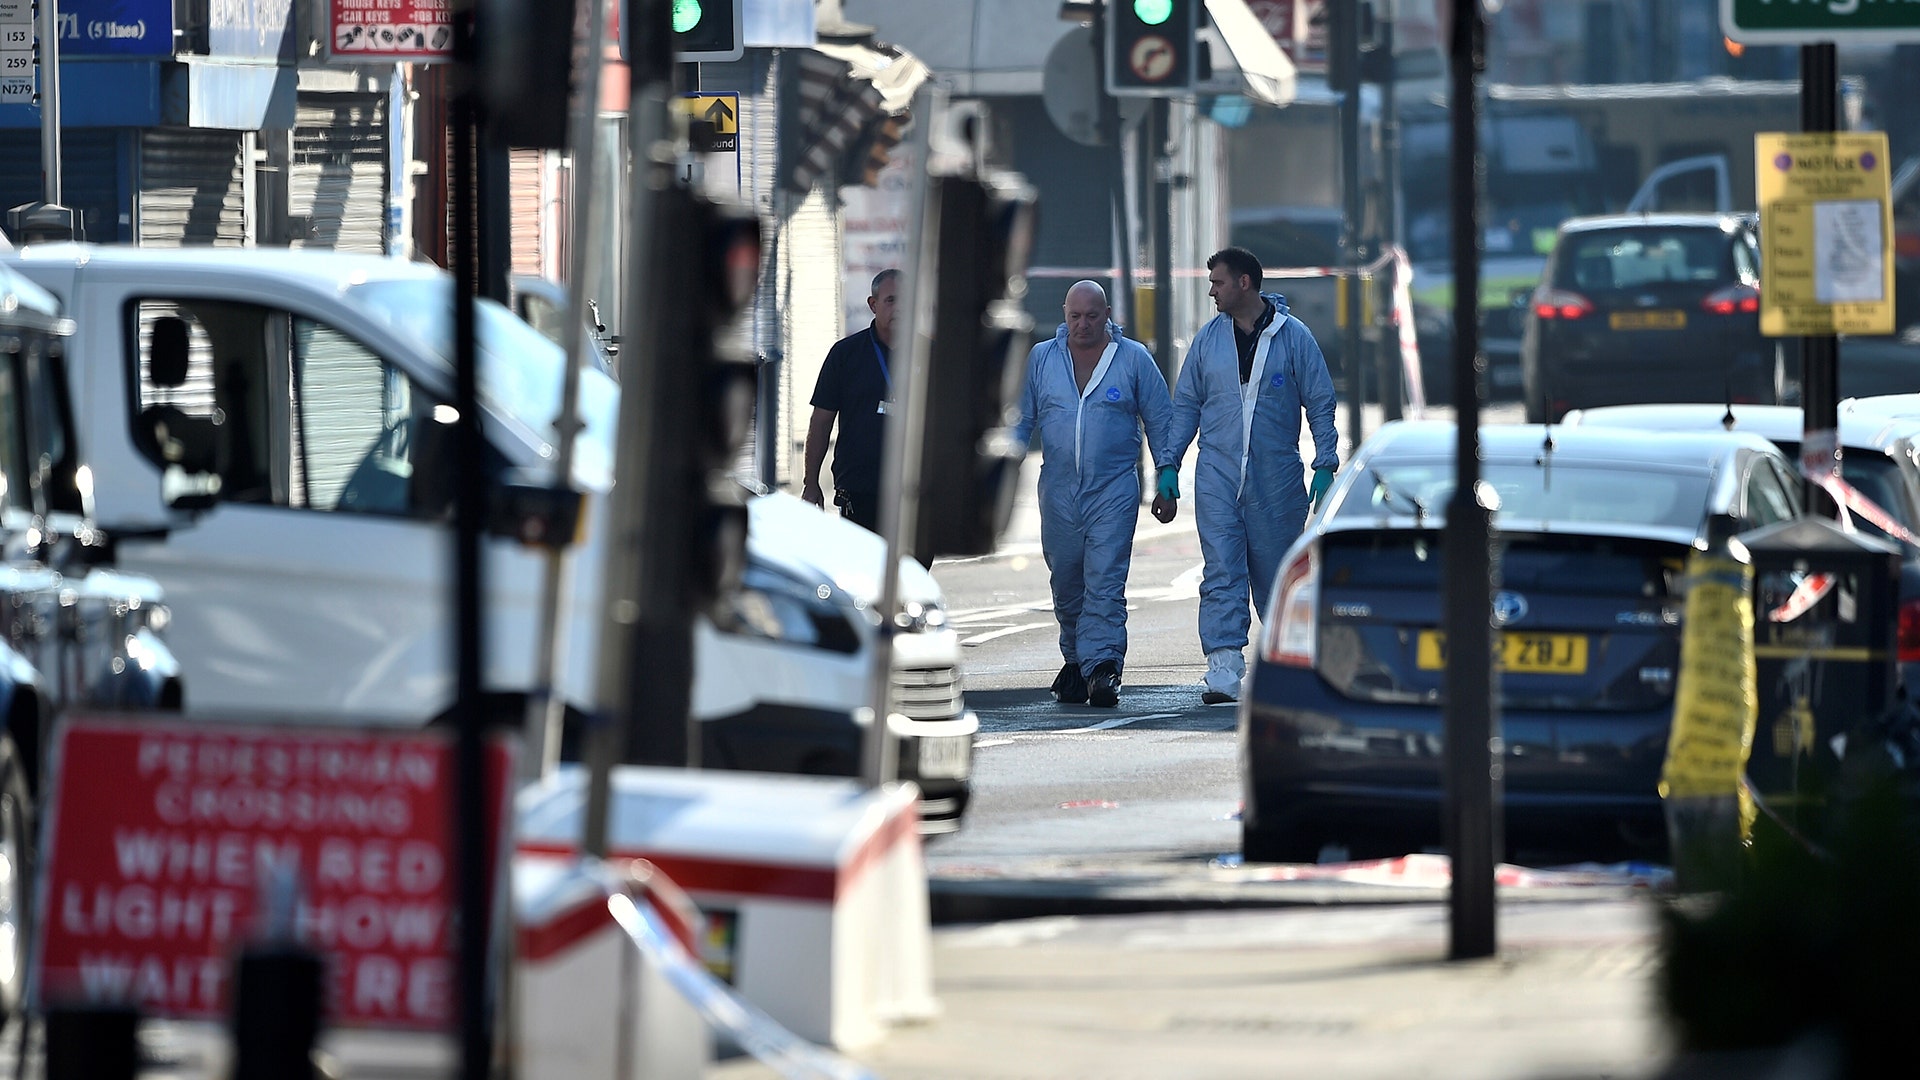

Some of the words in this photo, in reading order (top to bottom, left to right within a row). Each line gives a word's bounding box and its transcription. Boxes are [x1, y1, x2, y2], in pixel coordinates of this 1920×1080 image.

[343, 10, 364, 22] CAR
[365, 10, 391, 23] KEYS
[414, 10, 433, 22] FOB
[435, 10, 453, 22] KEY
[7, 31, 26, 42] 153
[6, 58, 27, 69] 259
[2, 84, 32, 95] N279
[138, 737, 438, 791] PEDESTRIAN
[156, 782, 412, 830] CROSSING
[114, 827, 303, 886] WHEN
[317, 838, 444, 894] RED
[61, 883, 235, 938] LIGHT
[79, 957, 224, 1004] WAIT
